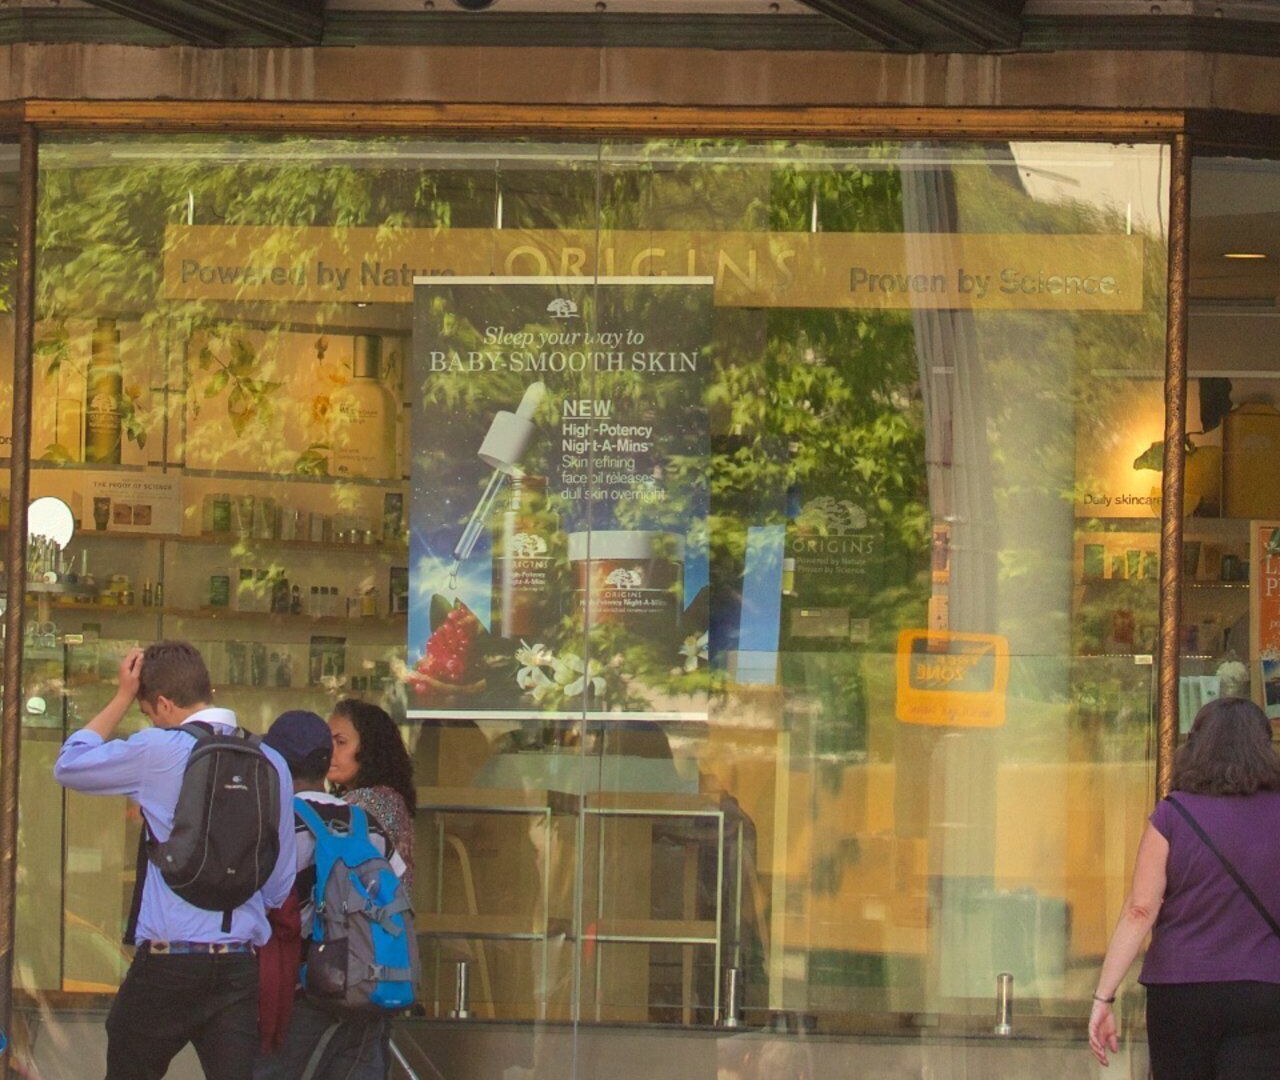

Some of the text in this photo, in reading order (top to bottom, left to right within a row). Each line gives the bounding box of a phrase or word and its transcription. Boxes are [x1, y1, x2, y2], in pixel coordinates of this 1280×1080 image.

[181, 259, 306, 287] Powered
[317, 261, 352, 291] by
[505, 245, 795, 293] ORIGINS
[850, 267, 946, 294] Proven
[958, 269, 992, 299] by
[484, 326, 645, 349] Sleep your way to
[430, 351, 699, 373] BABY-SMOOTH SKIN
[563, 399, 612, 418] NEW
[562, 423, 653, 439] High-Potency
[562, 454, 635, 472] Skin refining
[561, 470, 588, 484] face
[606, 471, 656, 485] releases
[561, 486, 582, 500] dull
[584, 487, 609, 500] skin
[792, 538, 874, 554] ORIGINS
